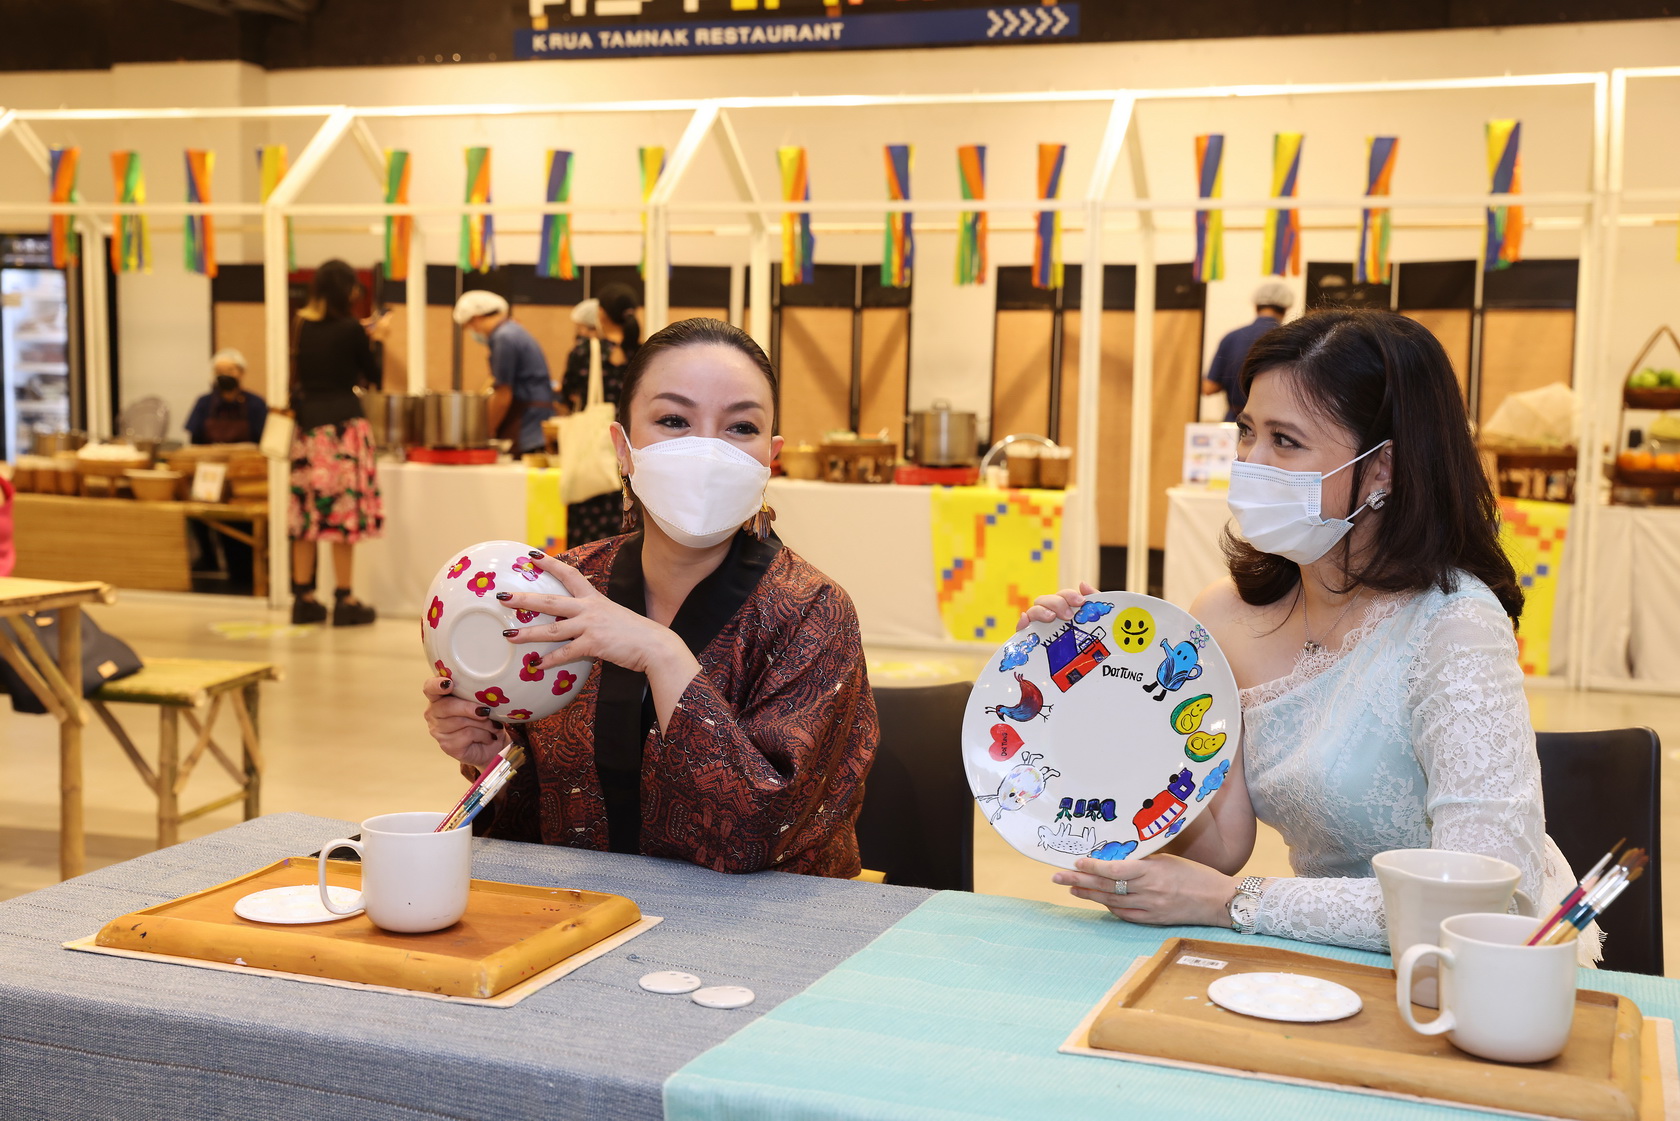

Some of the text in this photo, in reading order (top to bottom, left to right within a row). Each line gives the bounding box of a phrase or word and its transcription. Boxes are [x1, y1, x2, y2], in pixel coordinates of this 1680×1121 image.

[532, 22, 844, 52] KRUA TAMNAK RESTAURANT
